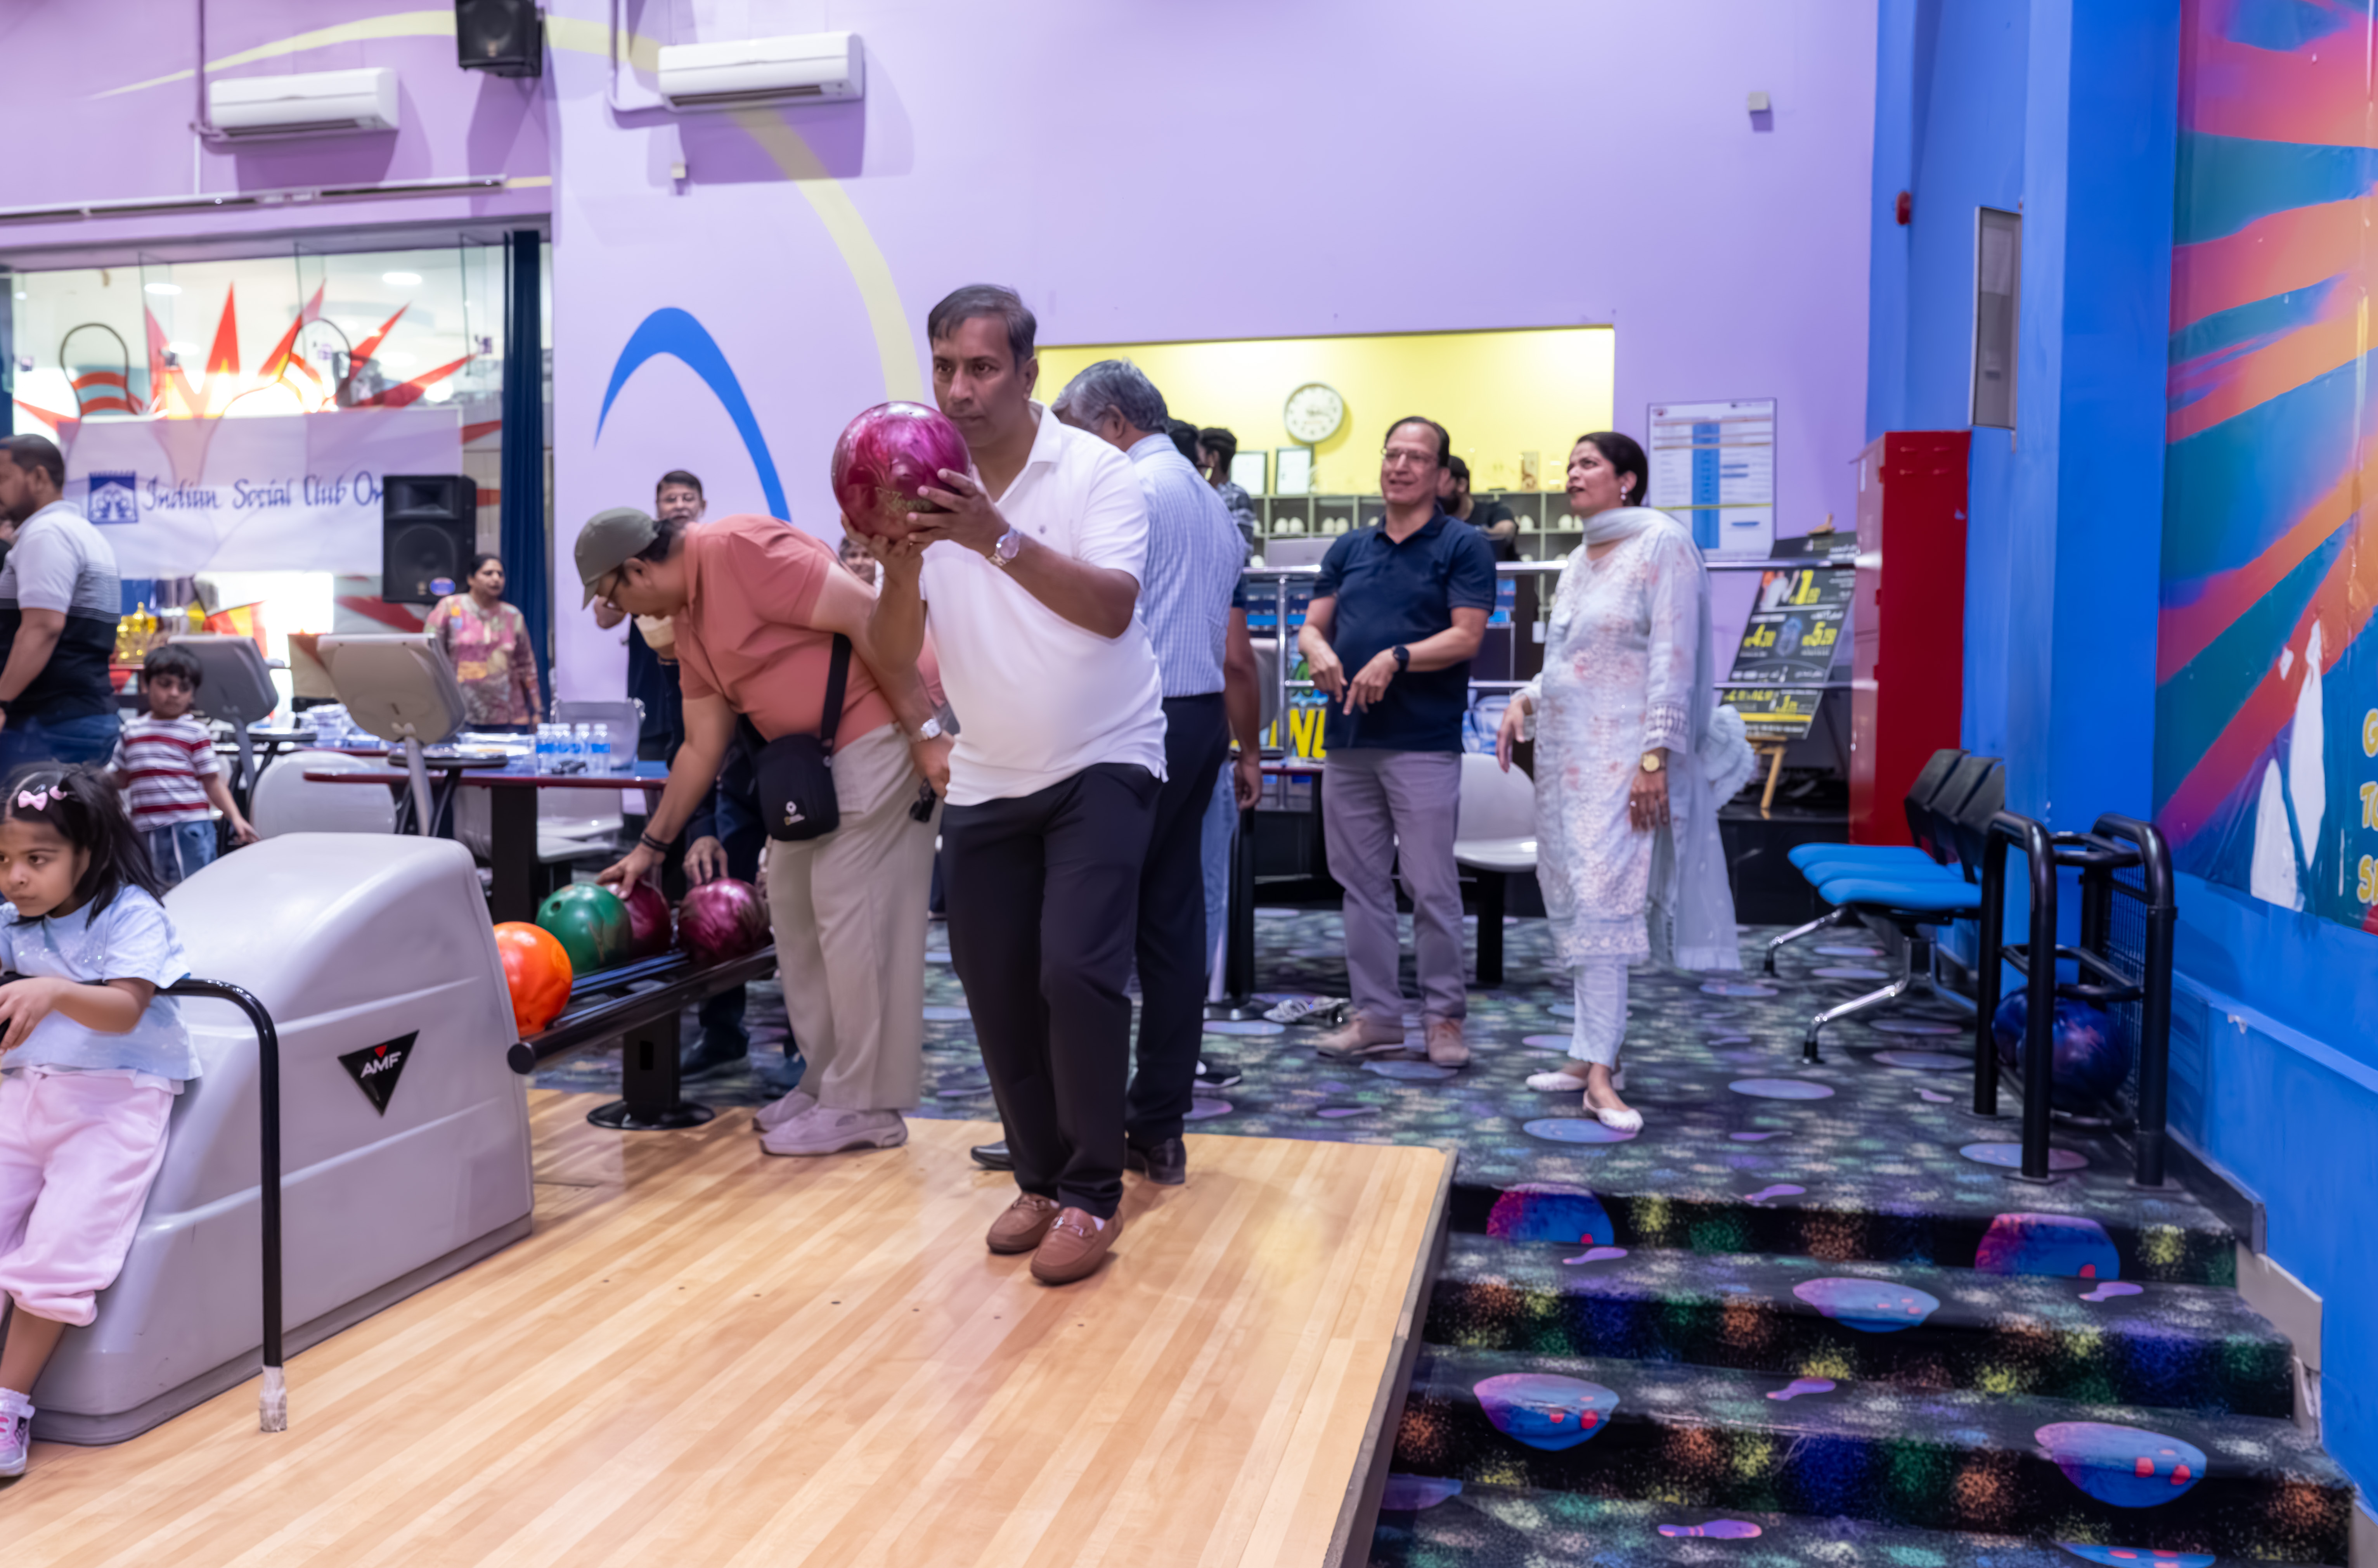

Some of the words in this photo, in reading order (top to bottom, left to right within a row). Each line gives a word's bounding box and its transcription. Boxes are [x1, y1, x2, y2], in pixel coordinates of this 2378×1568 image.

[143, 475, 222, 511] Indian
[232, 478, 293, 509] Social
[304, 474, 347, 507] Club
[360, 1051, 402, 1078] AMF
